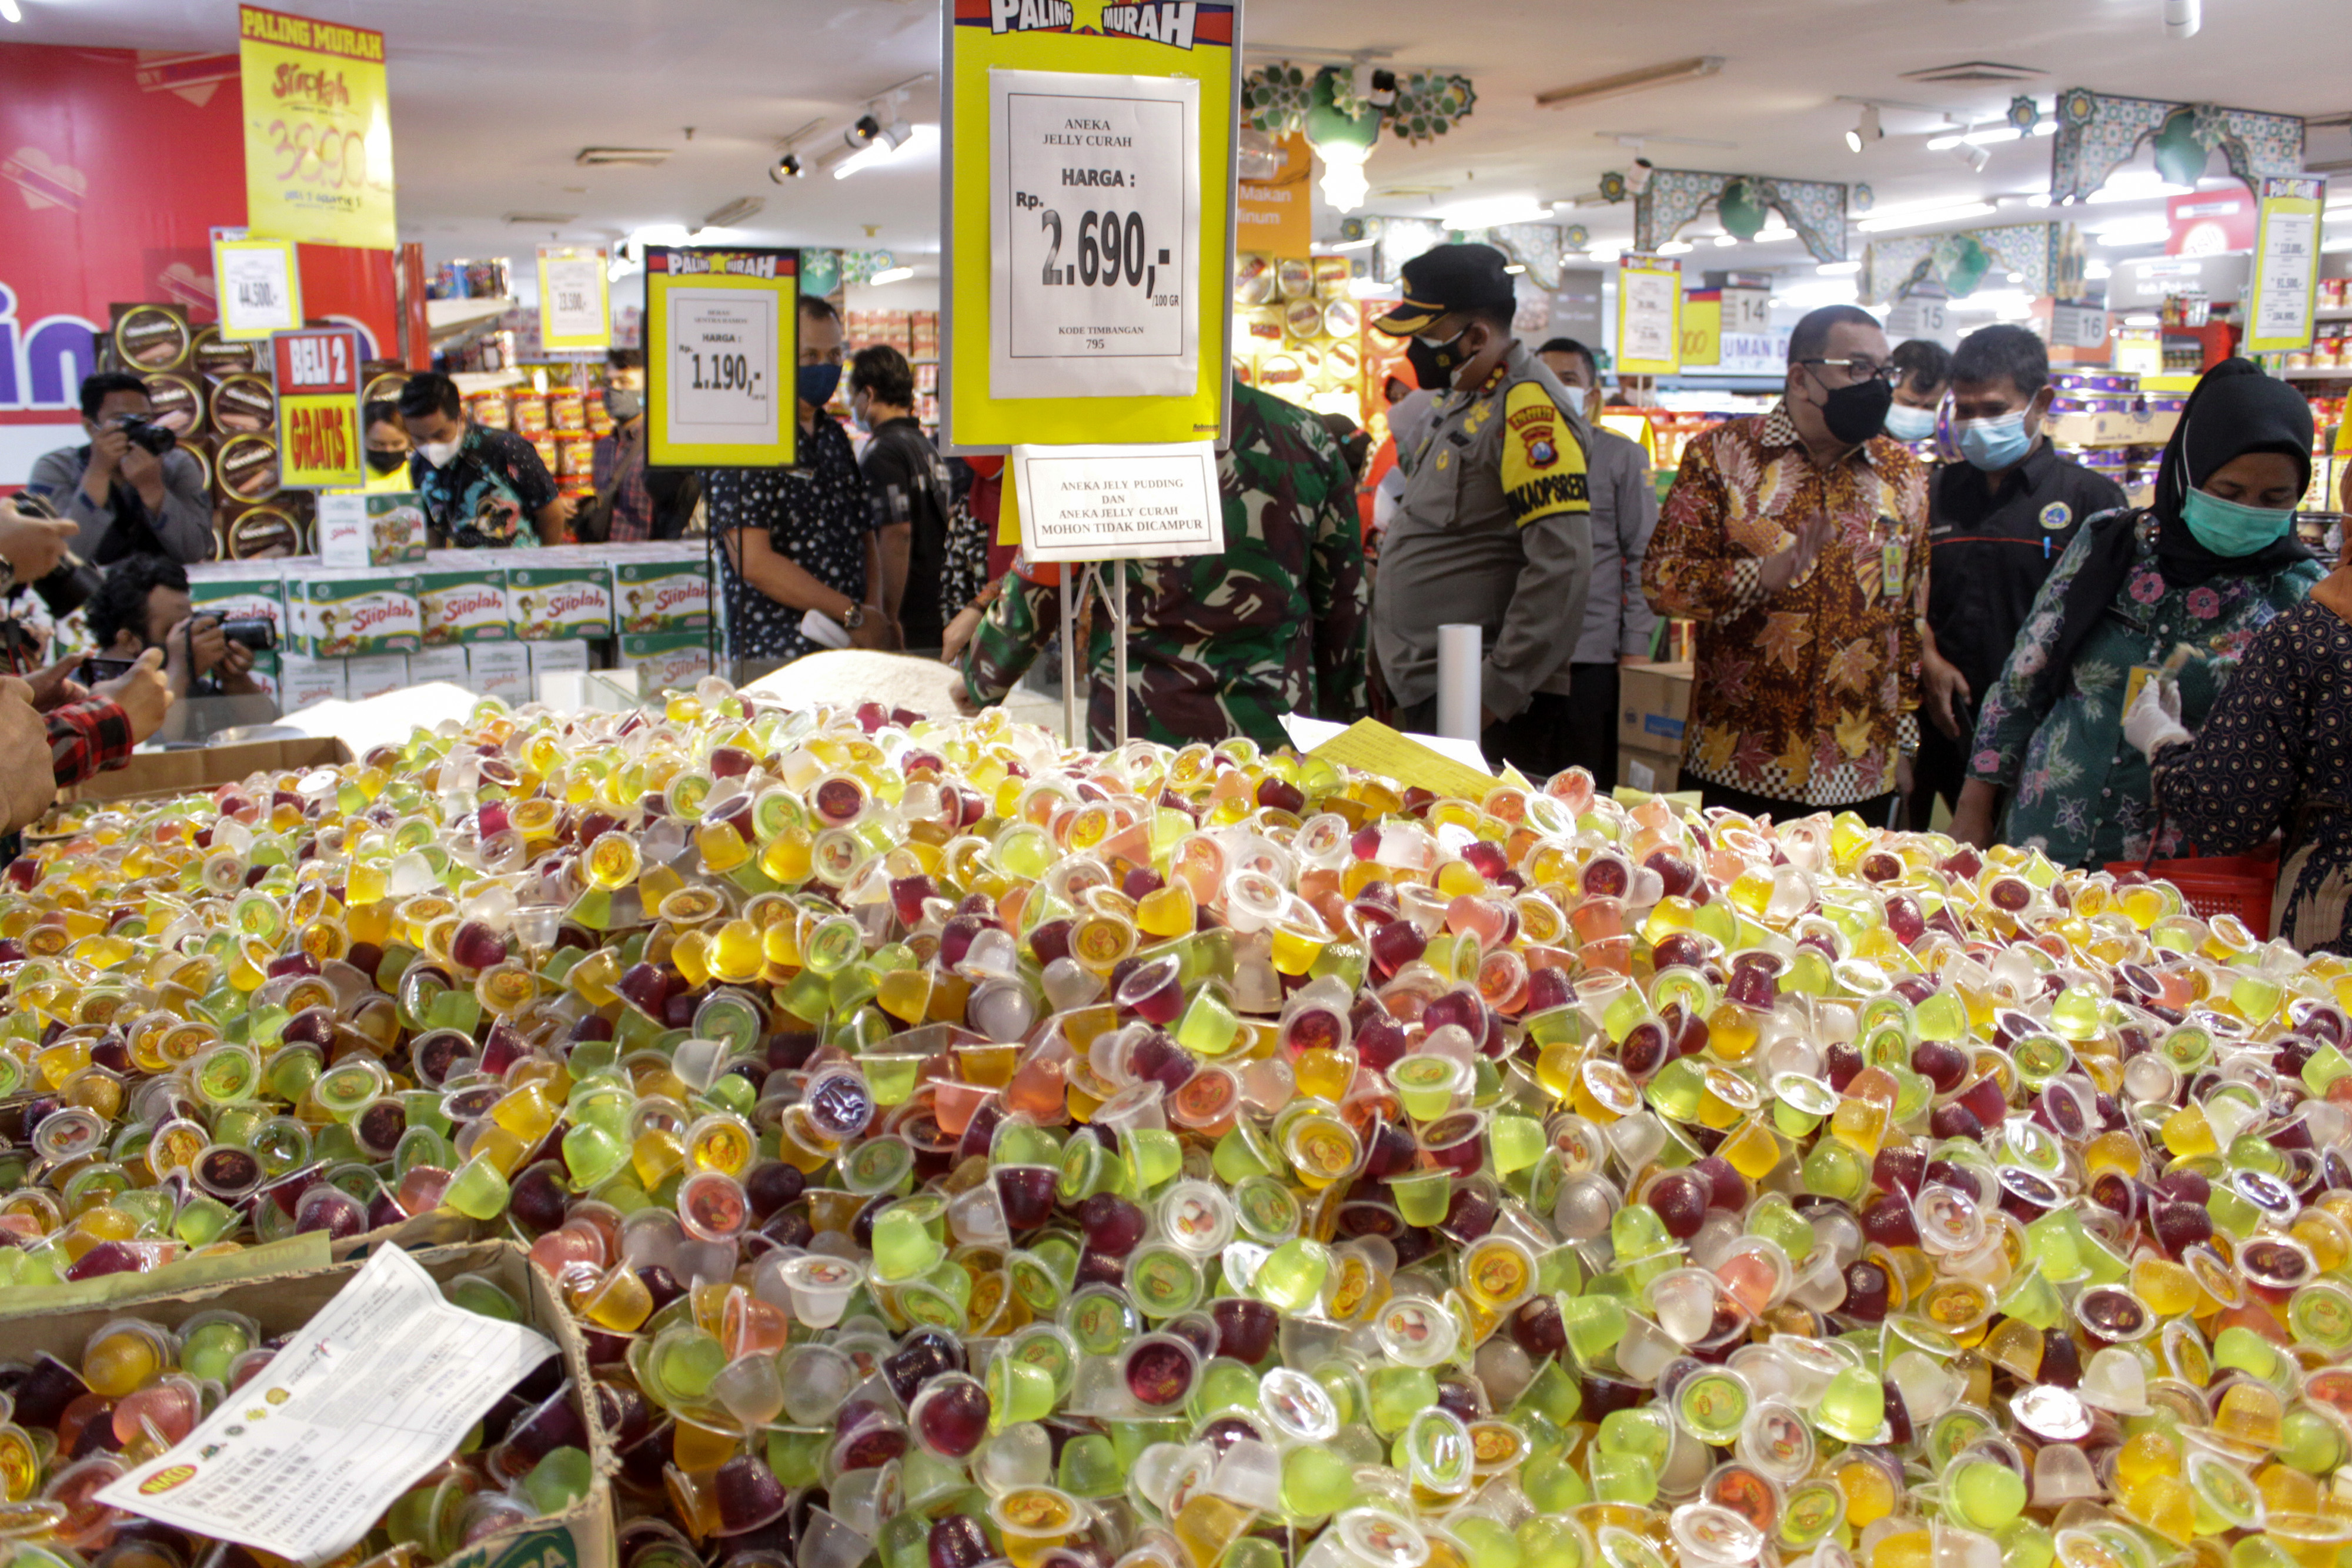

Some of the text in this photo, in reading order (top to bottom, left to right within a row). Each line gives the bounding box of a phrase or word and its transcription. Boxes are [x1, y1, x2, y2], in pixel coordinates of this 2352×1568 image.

[241, 9, 383, 59] PALING MURAH
[990, 0, 1197, 50] PALING MURAH
[1065, 119, 1111, 131] ANEKA
[1043, 134, 1132, 148] JELLY CURAH
[1062, 169, 1124, 187] HARGA
[1016, 192, 1043, 210] Rp.
[1240, 186, 1292, 203] Makan
[1238, 208, 1281, 224] inum
[1042, 209, 1170, 299] 2.690,-
[667, 252, 777, 280] PALING MURAH
[1169, 295, 1179, 306] GR
[1741, 297, 1766, 322] 14
[1922, 306, 1943, 330] 15
[2083, 316, 2102, 338] 16
[703, 334, 736, 343] HARGA
[1058, 326, 1144, 335] KODE TIMBANGAN
[1086, 339, 1104, 349] 795
[289, 336, 348, 386] BELI 2
[692, 353, 760, 397] 1.190,-
[290, 406, 346, 471] GRATIS
[1061, 479, 1184, 491] ANEKA JELY PUDDING
[1102, 495, 1125, 504] DAN
[1059, 506, 1178, 519] ANEKA JELLY CURAH
[1041, 519, 1203, 535] MOHON TIDAK DICAMPUR
[444, 591, 502, 623] Siiplah
[547, 589, 606, 618] Siiplah
[352, 599, 414, 632] Siiplah
[141, 1466, 194, 1494] INACO
[284, 1505, 329, 1544] EXPIRED
[327, 1480, 353, 1505] DATE
